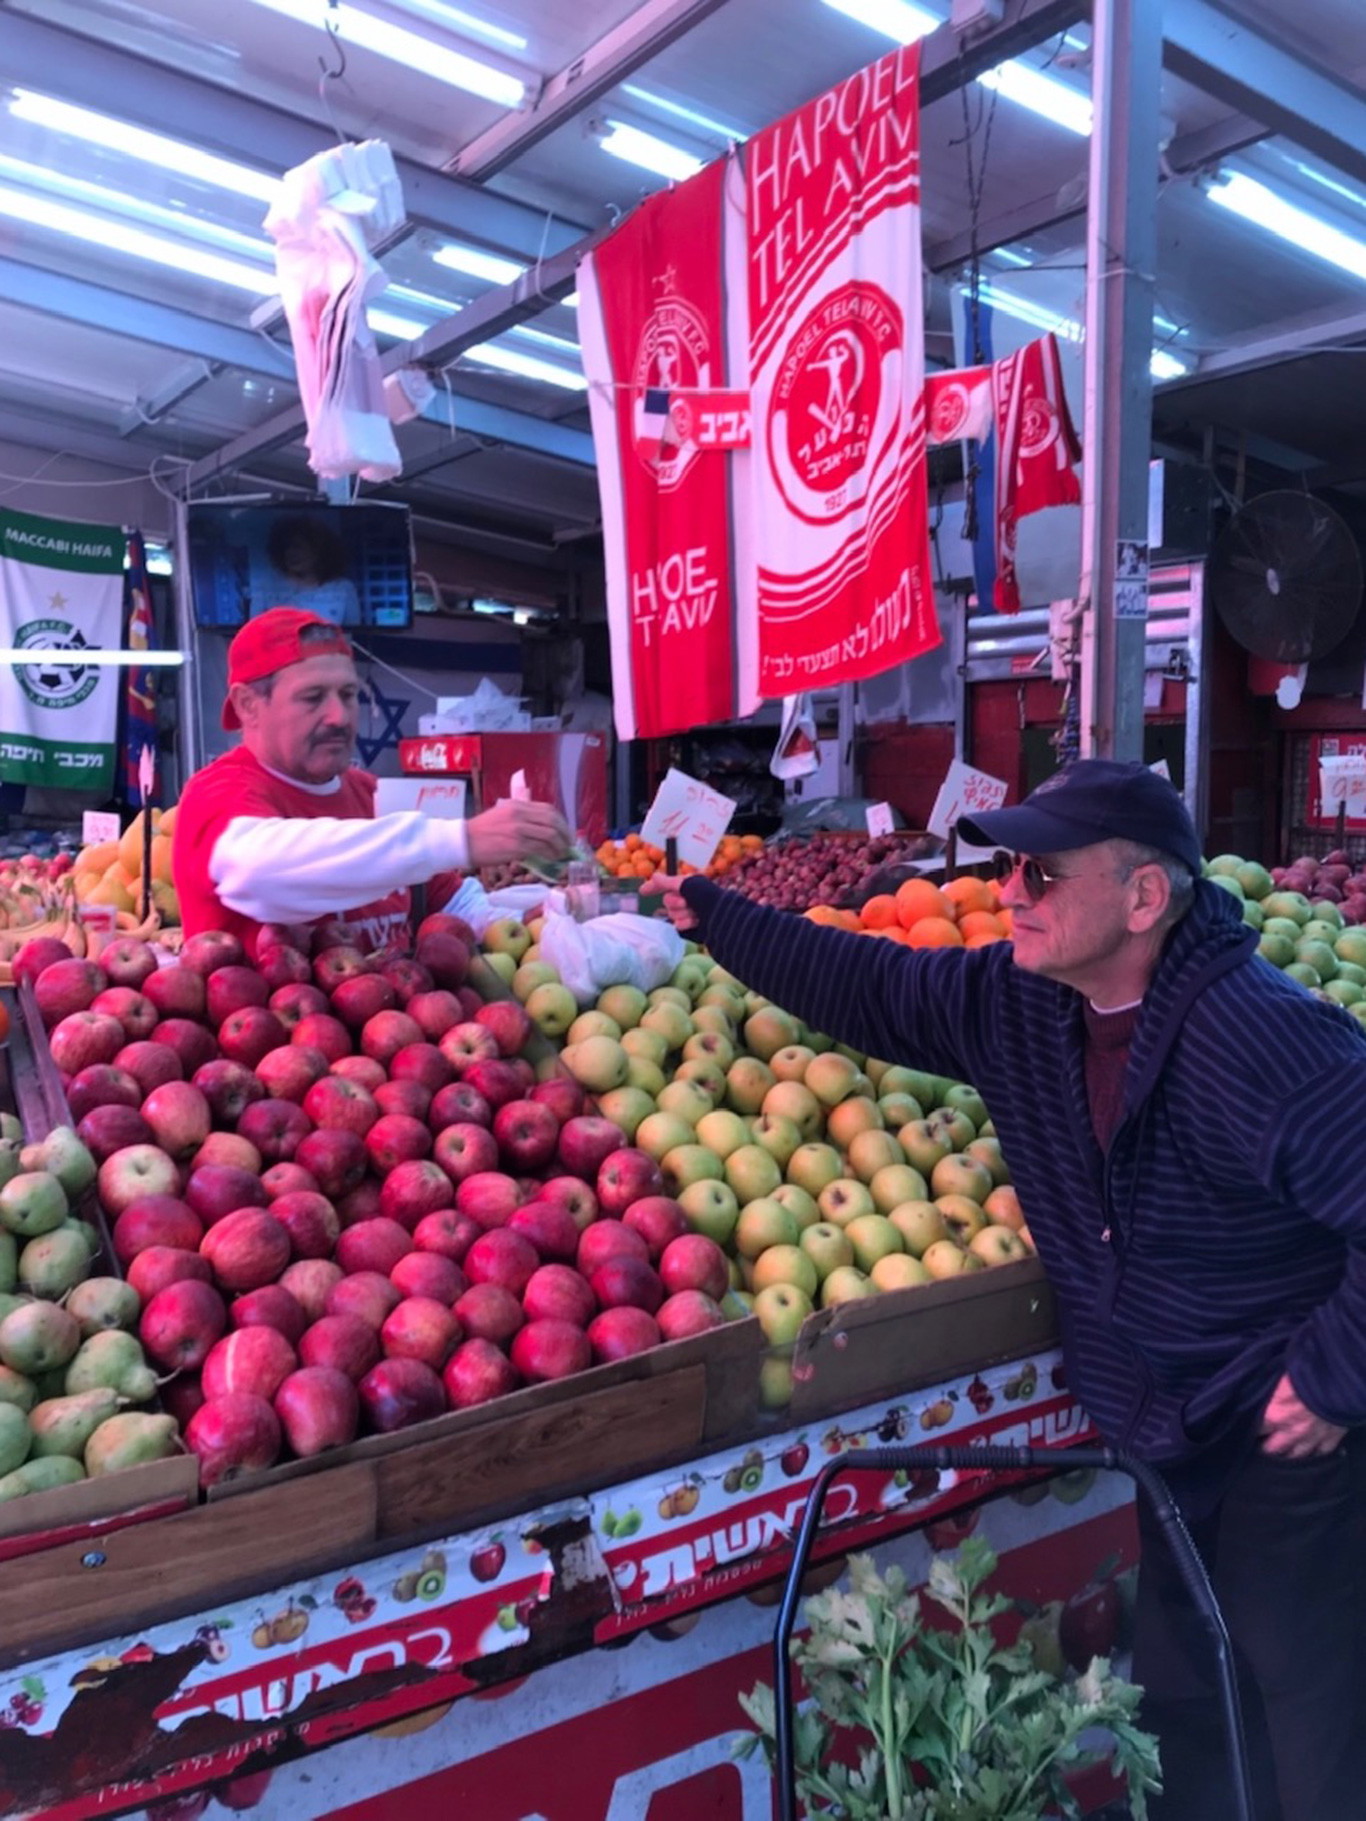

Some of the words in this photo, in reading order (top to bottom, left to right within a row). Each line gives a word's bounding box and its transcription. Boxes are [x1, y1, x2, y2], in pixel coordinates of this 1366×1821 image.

[752, 48, 914, 236] HAPOEL
[752, 197, 814, 308] TEL
[823, 108, 913, 216] AVIV
[5, 527, 70, 553] MACCABI
[71, 542, 112, 558] HAIFA
[1, 744, 44, 762] חיפה
[54, 752, 104, 767] מכבי
